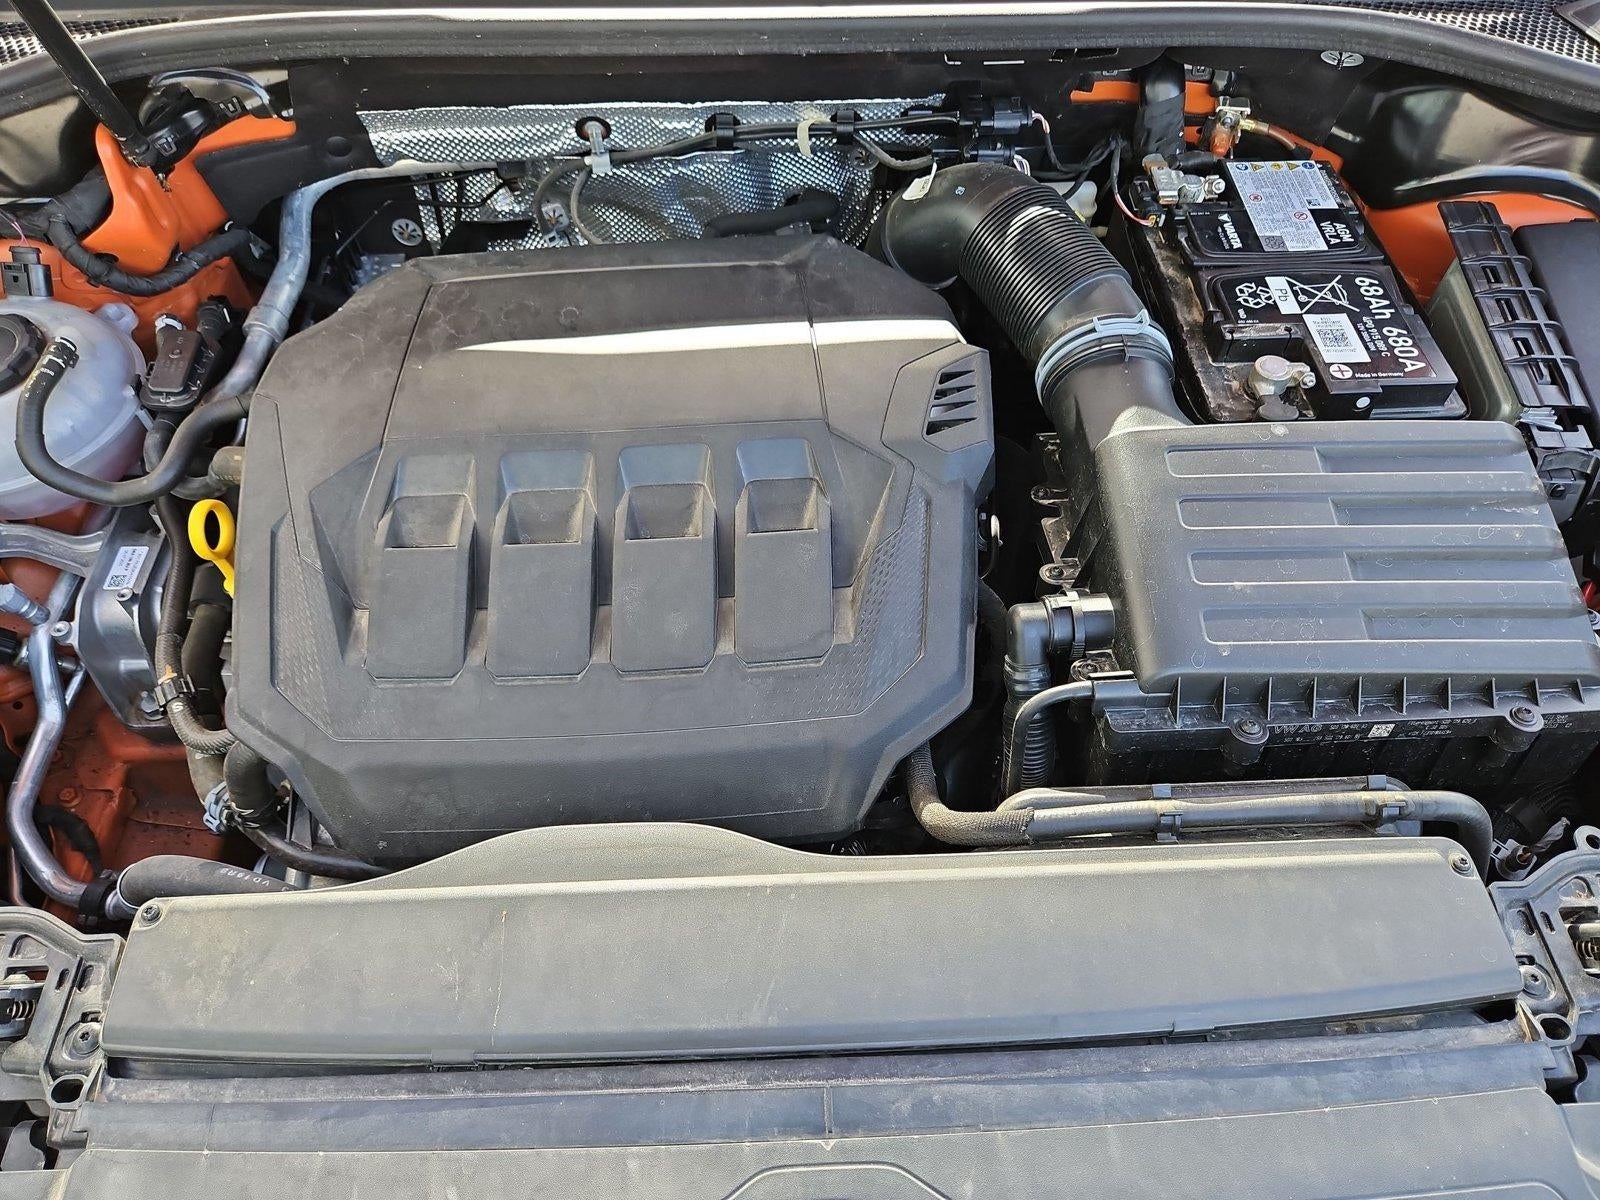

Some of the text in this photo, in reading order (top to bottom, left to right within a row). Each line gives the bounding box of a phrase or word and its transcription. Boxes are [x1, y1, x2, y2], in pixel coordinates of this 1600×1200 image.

[1223, 222, 1243, 249] VARTA
[1320, 221, 1340, 245] VRLA
[1333, 222, 1355, 242] AGM
[1275, 288, 1290, 302] Pb
[1355, 277, 1427, 373] 68Ah 680A
[1369, 328, 1381, 340] 915
